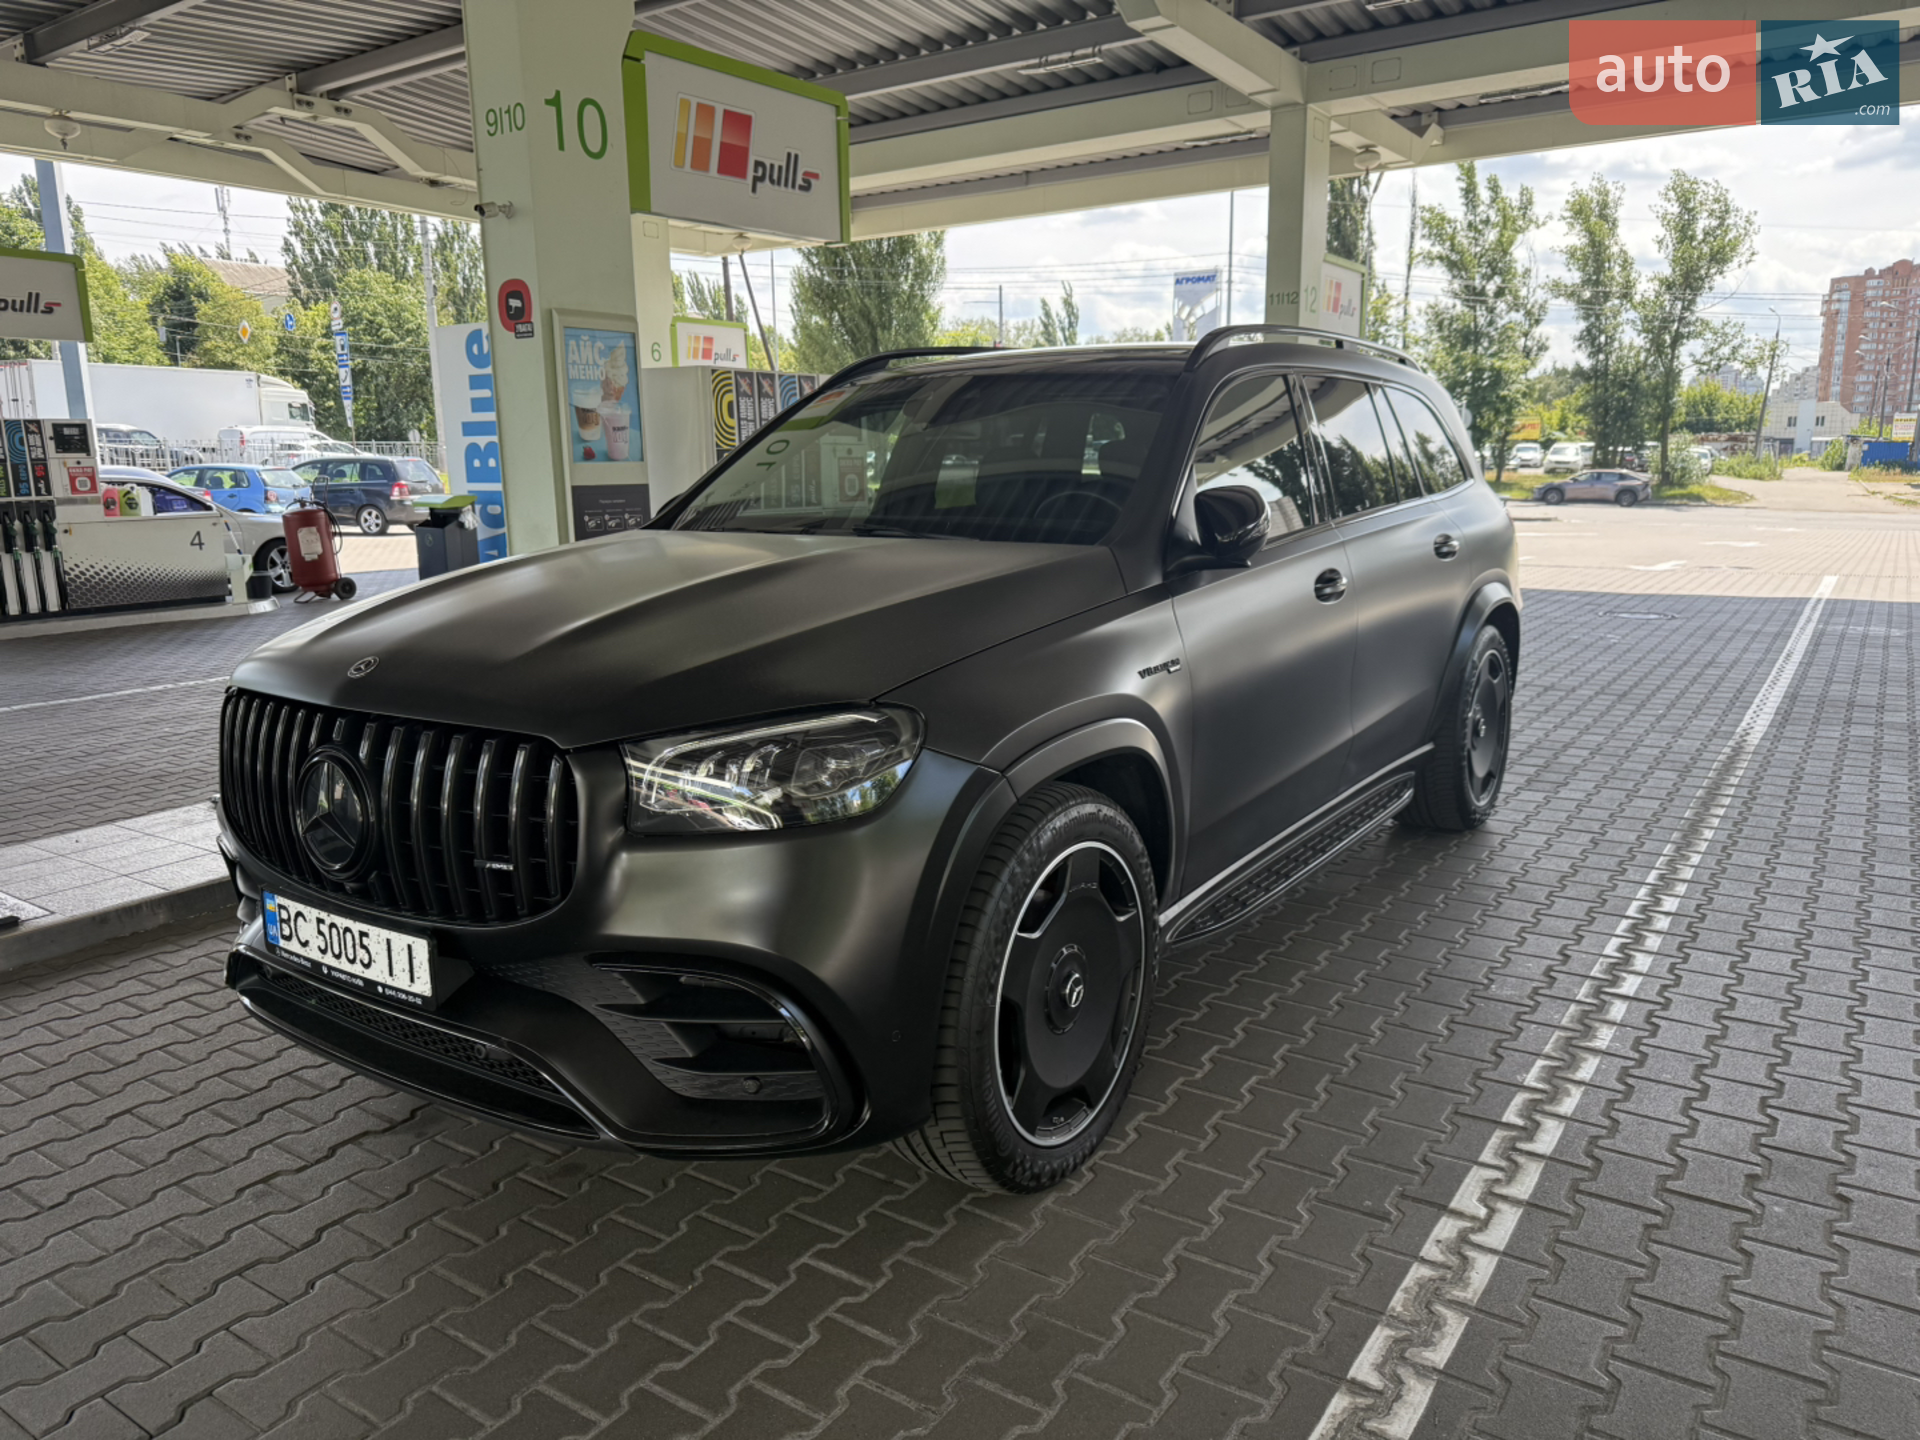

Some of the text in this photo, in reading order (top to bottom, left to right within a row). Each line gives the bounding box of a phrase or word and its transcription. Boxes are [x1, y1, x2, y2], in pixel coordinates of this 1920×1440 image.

[544, 89, 608, 160] 10
[751, 152, 820, 195] pulls
[1304, 284, 1317, 313] 12
[1339, 298, 1357, 319] pulls
[568, 335, 606, 365] АЙС
[651, 341, 662, 362] 6
[713, 348, 739, 364] pulls
[568, 364, 606, 380] МЕНЮ
[34, 464, 46, 478] 95
[19, 482, 30, 495] 95
[190, 530, 205, 551] 4
[277, 903, 310, 948] BC
[316, 916, 373, 970] 5005
